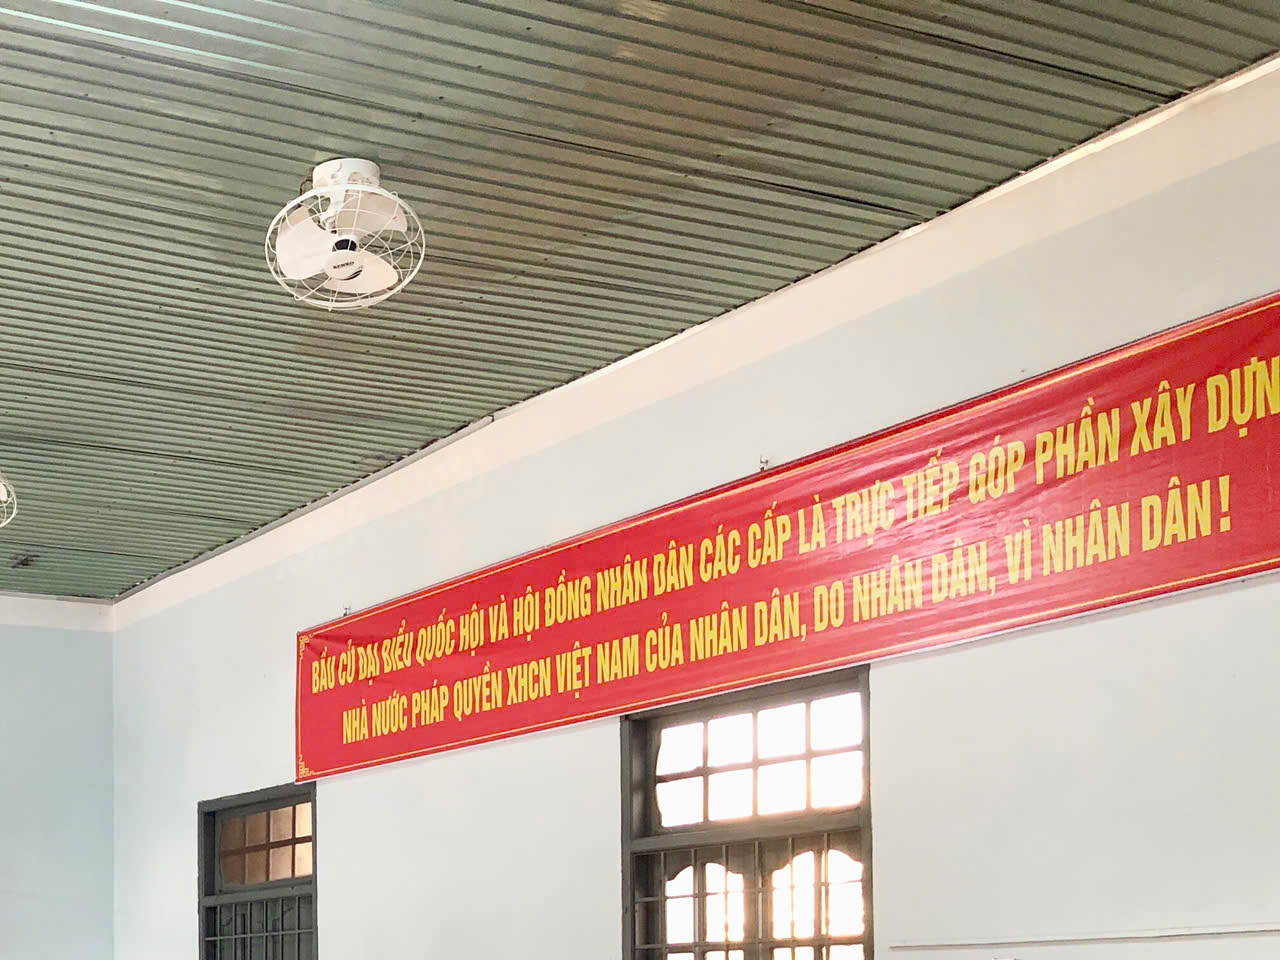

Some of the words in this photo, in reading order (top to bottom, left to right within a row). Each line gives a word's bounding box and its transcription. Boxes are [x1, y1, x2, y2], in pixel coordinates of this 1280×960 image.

[312, 646, 335, 694] BẦU
[357, 642, 380, 686] ĐẠI
[382, 619, 414, 673] BIỂU
[416, 608, 455, 668] QUỐC
[458, 603, 484, 656] HỘI
[489, 594, 509, 643] VÀ
[513, 585, 540, 641] HỘI
[544, 569, 591, 627] ĐỒNG
[596, 554, 648, 613] NHÂN
[652, 539, 694, 596] DÂN
[699, 524, 741, 583] CÁC
[747, 501, 792, 569] CẤP
[797, 494, 826, 555] LÀ
[831, 479, 896, 546] TRỰC
[902, 447, 960, 522] TIẾP
[968, 434, 1026, 505] GÓP
[1035, 396, 1120, 486] PHẦN
[1129, 379, 1196, 457] XÂY
[342, 698, 369, 744] NHÀ
[371, 690, 408, 738] NƯỚC
[411, 680, 449, 729] PHÁP
[452, 660, 503, 722] QUYỀN
[506, 656, 552, 706] XHCN
[554, 641, 593, 700] VIỆT
[596, 633, 640, 684] NAM
[645, 611, 684, 673] CỦA
[689, 601, 748, 663] NHÂN
[753, 587, 807, 647] DÂN,
[814, 580, 845, 633] DO
[852, 554, 923, 623] NHÂN
[931, 536, 996, 604] DÂN,
[1005, 518, 1033, 585] VÌ
[1042, 497, 1131, 577] NHÂN
